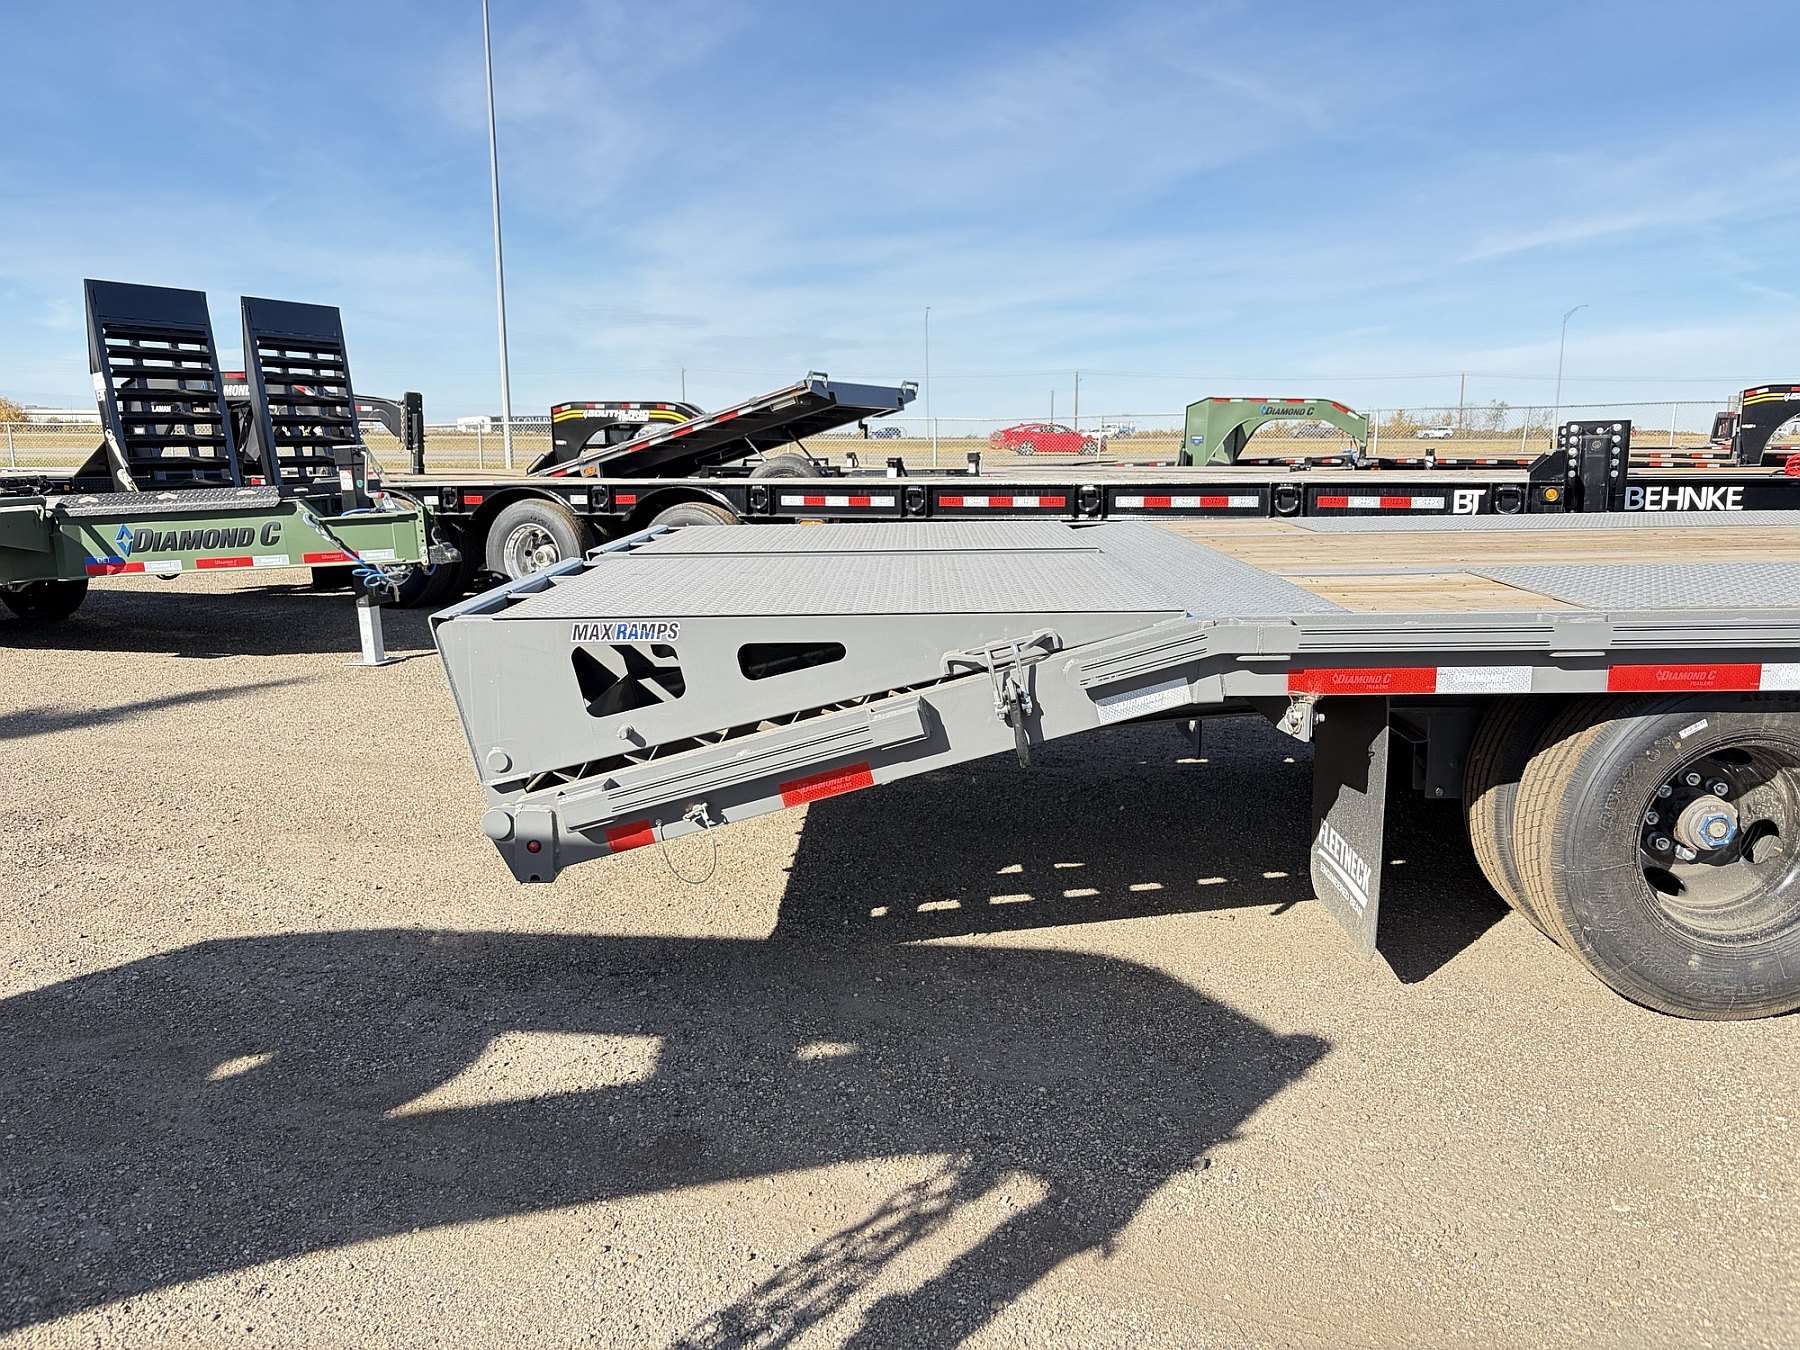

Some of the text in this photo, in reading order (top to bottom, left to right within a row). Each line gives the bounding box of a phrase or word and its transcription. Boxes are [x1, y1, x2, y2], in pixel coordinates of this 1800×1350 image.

[1453, 488, 1487, 516] BT
[1624, 486, 1745, 511] BEHNKE
[131, 520, 282, 553] DIAMOND C
[572, 622, 679, 641] MAX RAMPS
[1338, 673, 1392, 684] DIAMOND C
[1663, 670, 1717, 680] DIAMOND C
[1318, 819, 1371, 898] FLEETNECK
